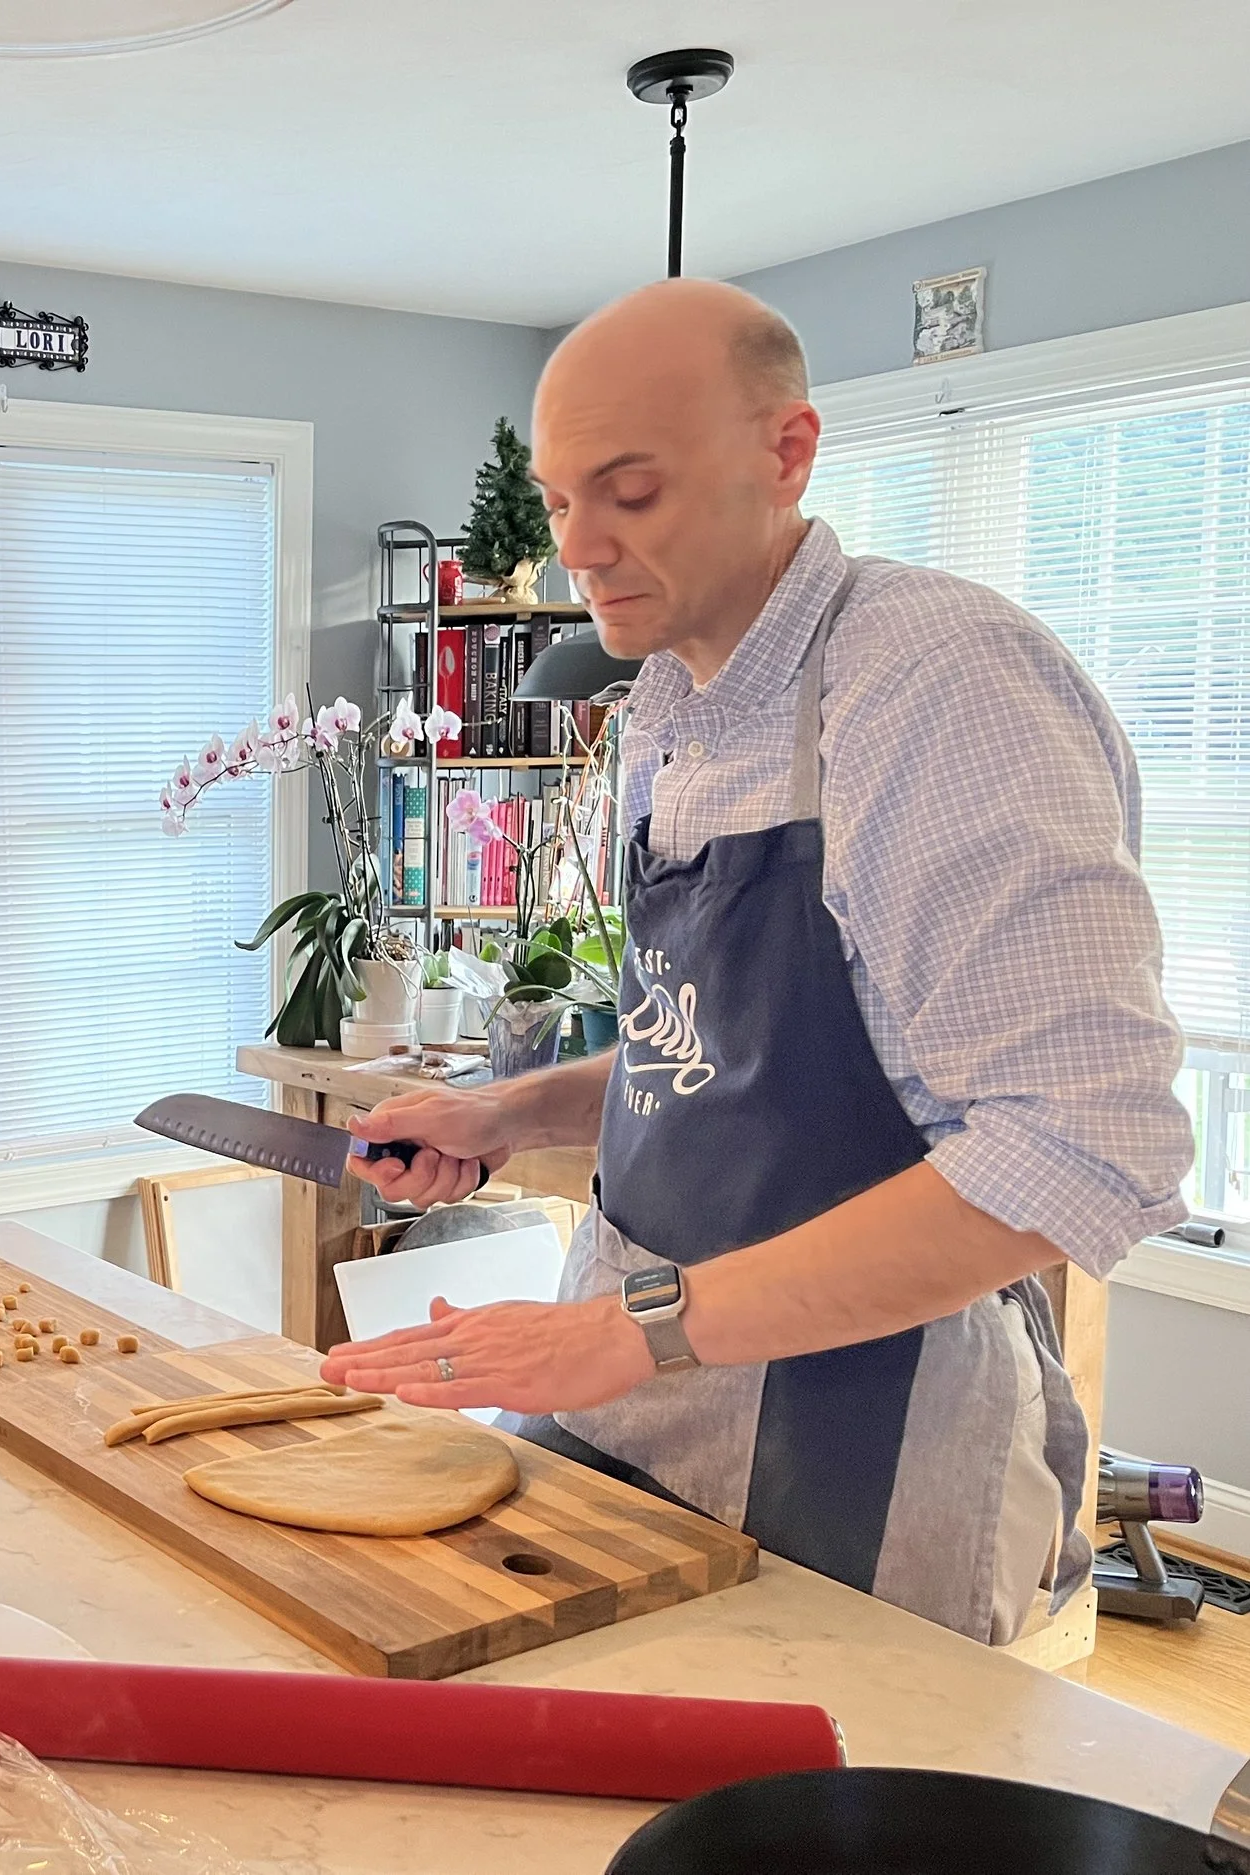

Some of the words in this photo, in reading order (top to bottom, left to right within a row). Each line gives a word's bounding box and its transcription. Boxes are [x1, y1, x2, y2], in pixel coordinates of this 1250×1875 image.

[16, 330, 64, 352] LORI
[485, 672, 498, 723] BAKING
[499, 686, 508, 714] ITALY
